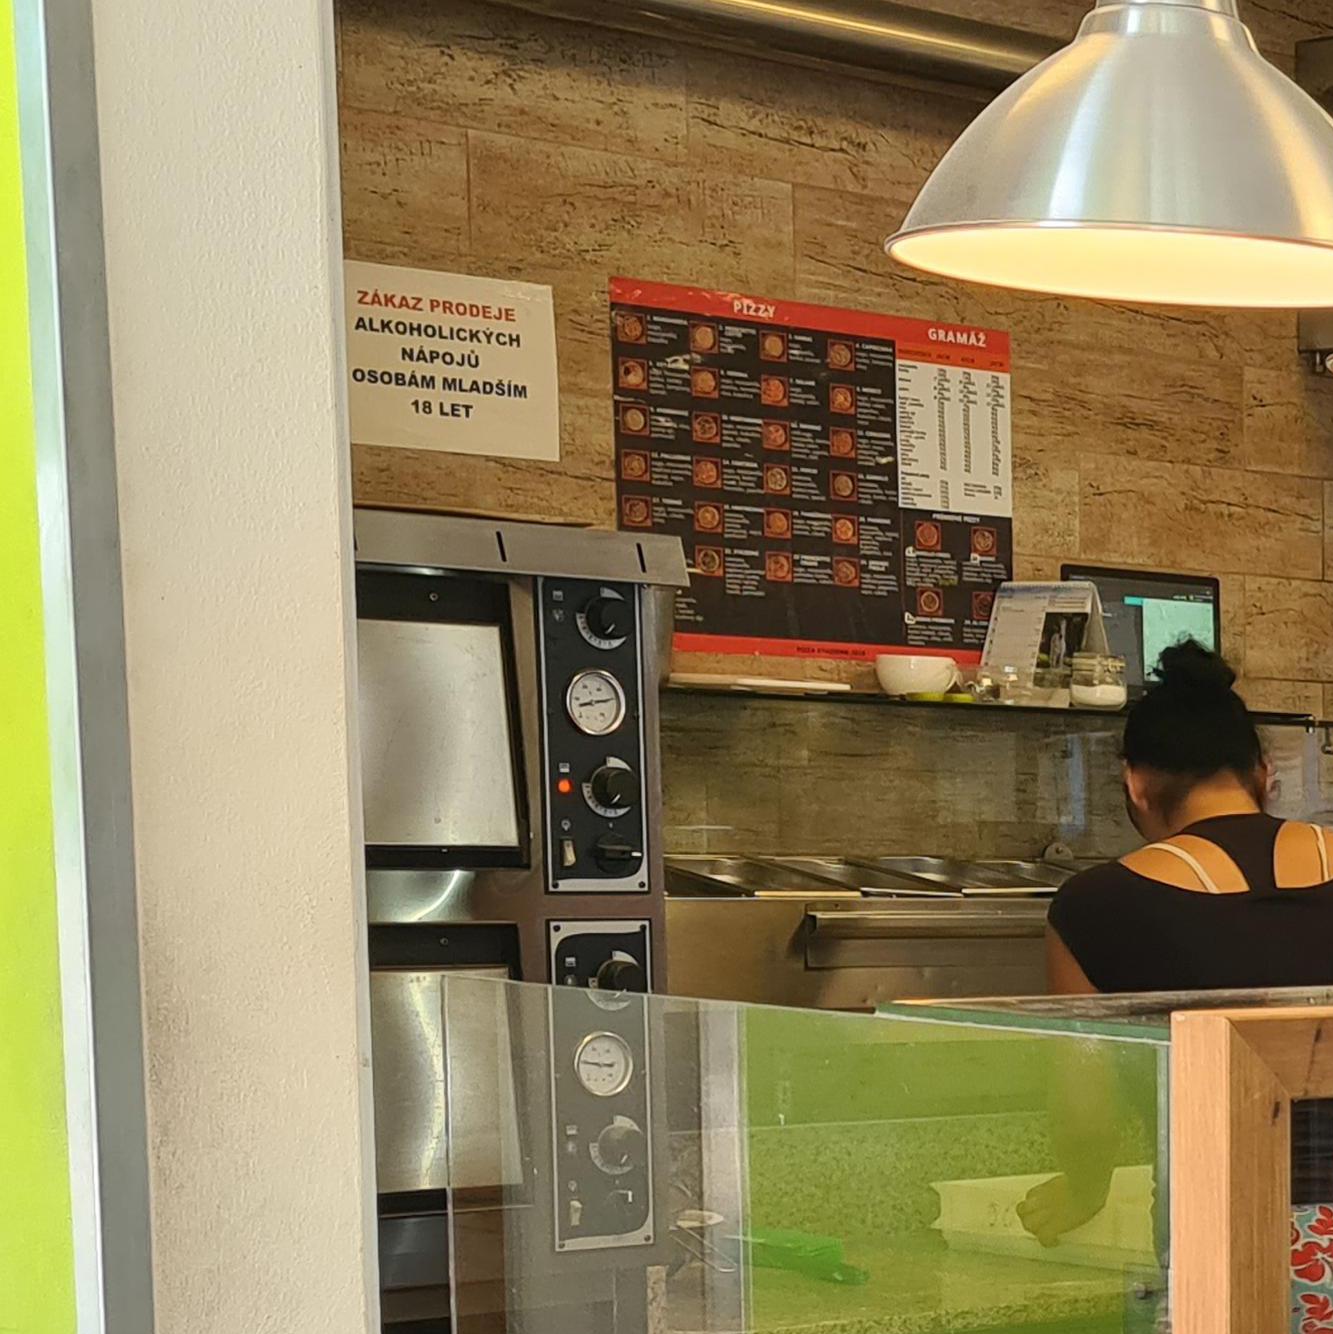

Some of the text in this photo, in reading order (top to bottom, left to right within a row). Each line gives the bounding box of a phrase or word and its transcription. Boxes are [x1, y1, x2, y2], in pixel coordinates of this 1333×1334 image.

[357, 289, 516, 322] ZÁKAZ PRODEJE
[733, 300, 776, 318] PIZZY
[355, 317, 521, 348] ALKOHOLICKÝCH
[928, 327, 987, 348] GRAMÁŽ
[401, 346, 480, 368] NÁPOJŮ
[352, 368, 528, 399] OSOBÁM MLADŠÍM
[411, 400, 473, 418] 18 LET
